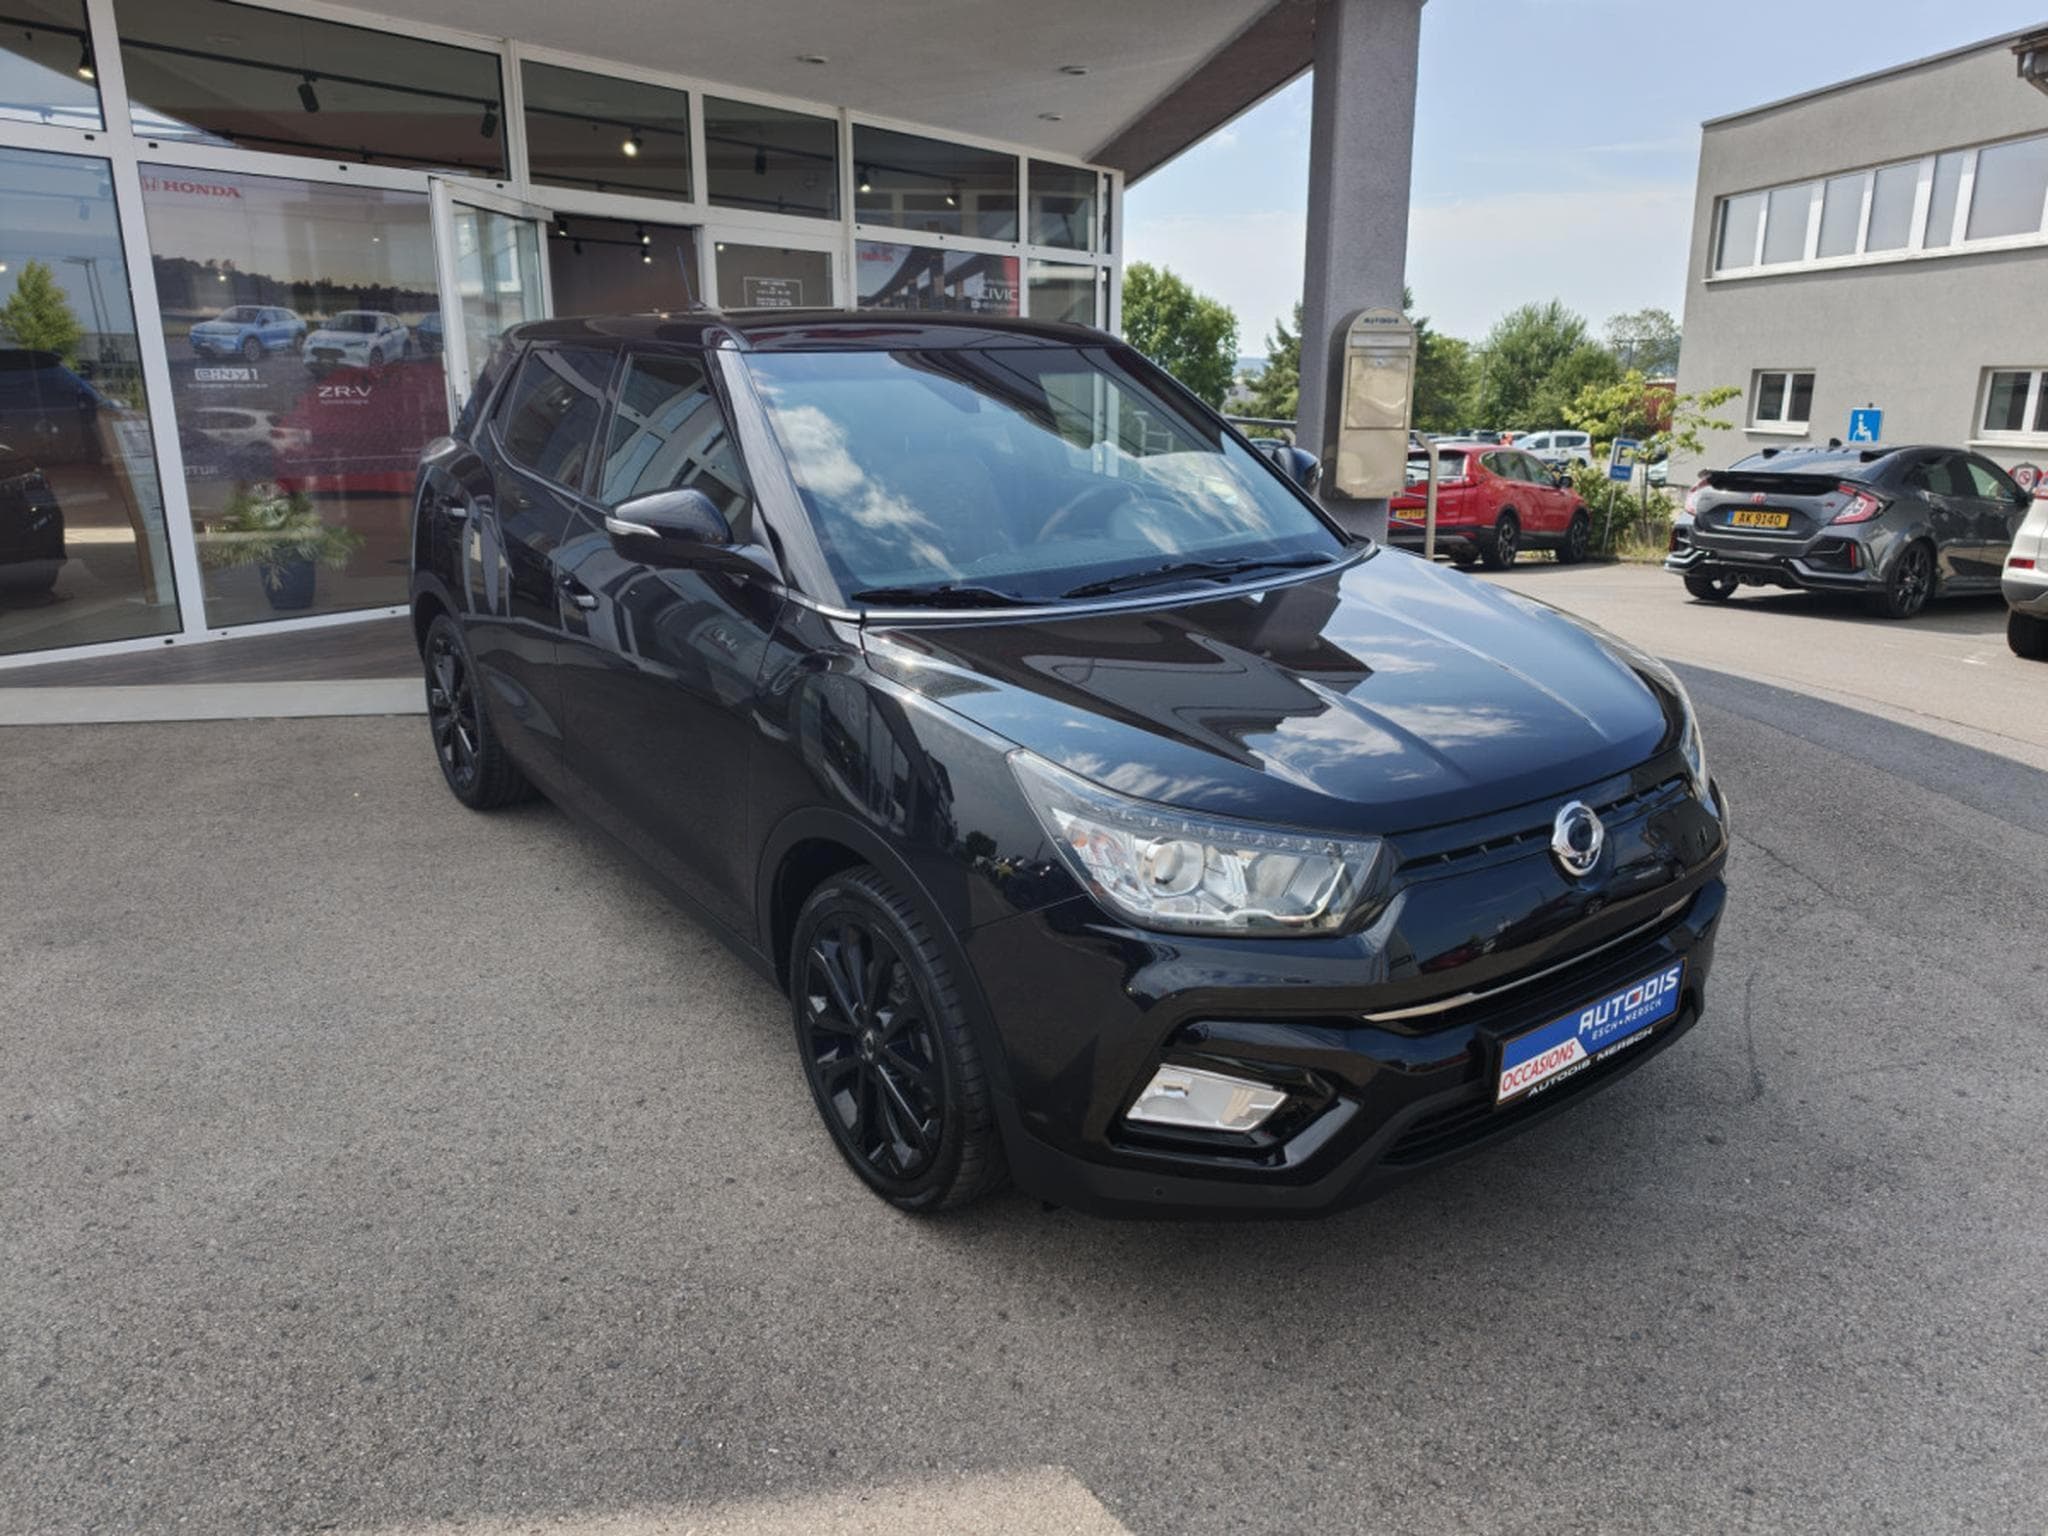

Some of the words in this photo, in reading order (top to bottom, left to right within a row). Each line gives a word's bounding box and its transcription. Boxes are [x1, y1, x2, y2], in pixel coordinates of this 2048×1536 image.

[163, 180, 242, 199] HONDA
[317, 385, 373, 398] ZR-V
[1755, 513, 1782, 526] 9140
[1578, 967, 1681, 1036] AUTODIS
[1502, 1040, 1576, 1092] OCCASIONS
[1527, 1058, 1591, 1097] AUTODIS
[1597, 1025, 1654, 1061] MERSCH
